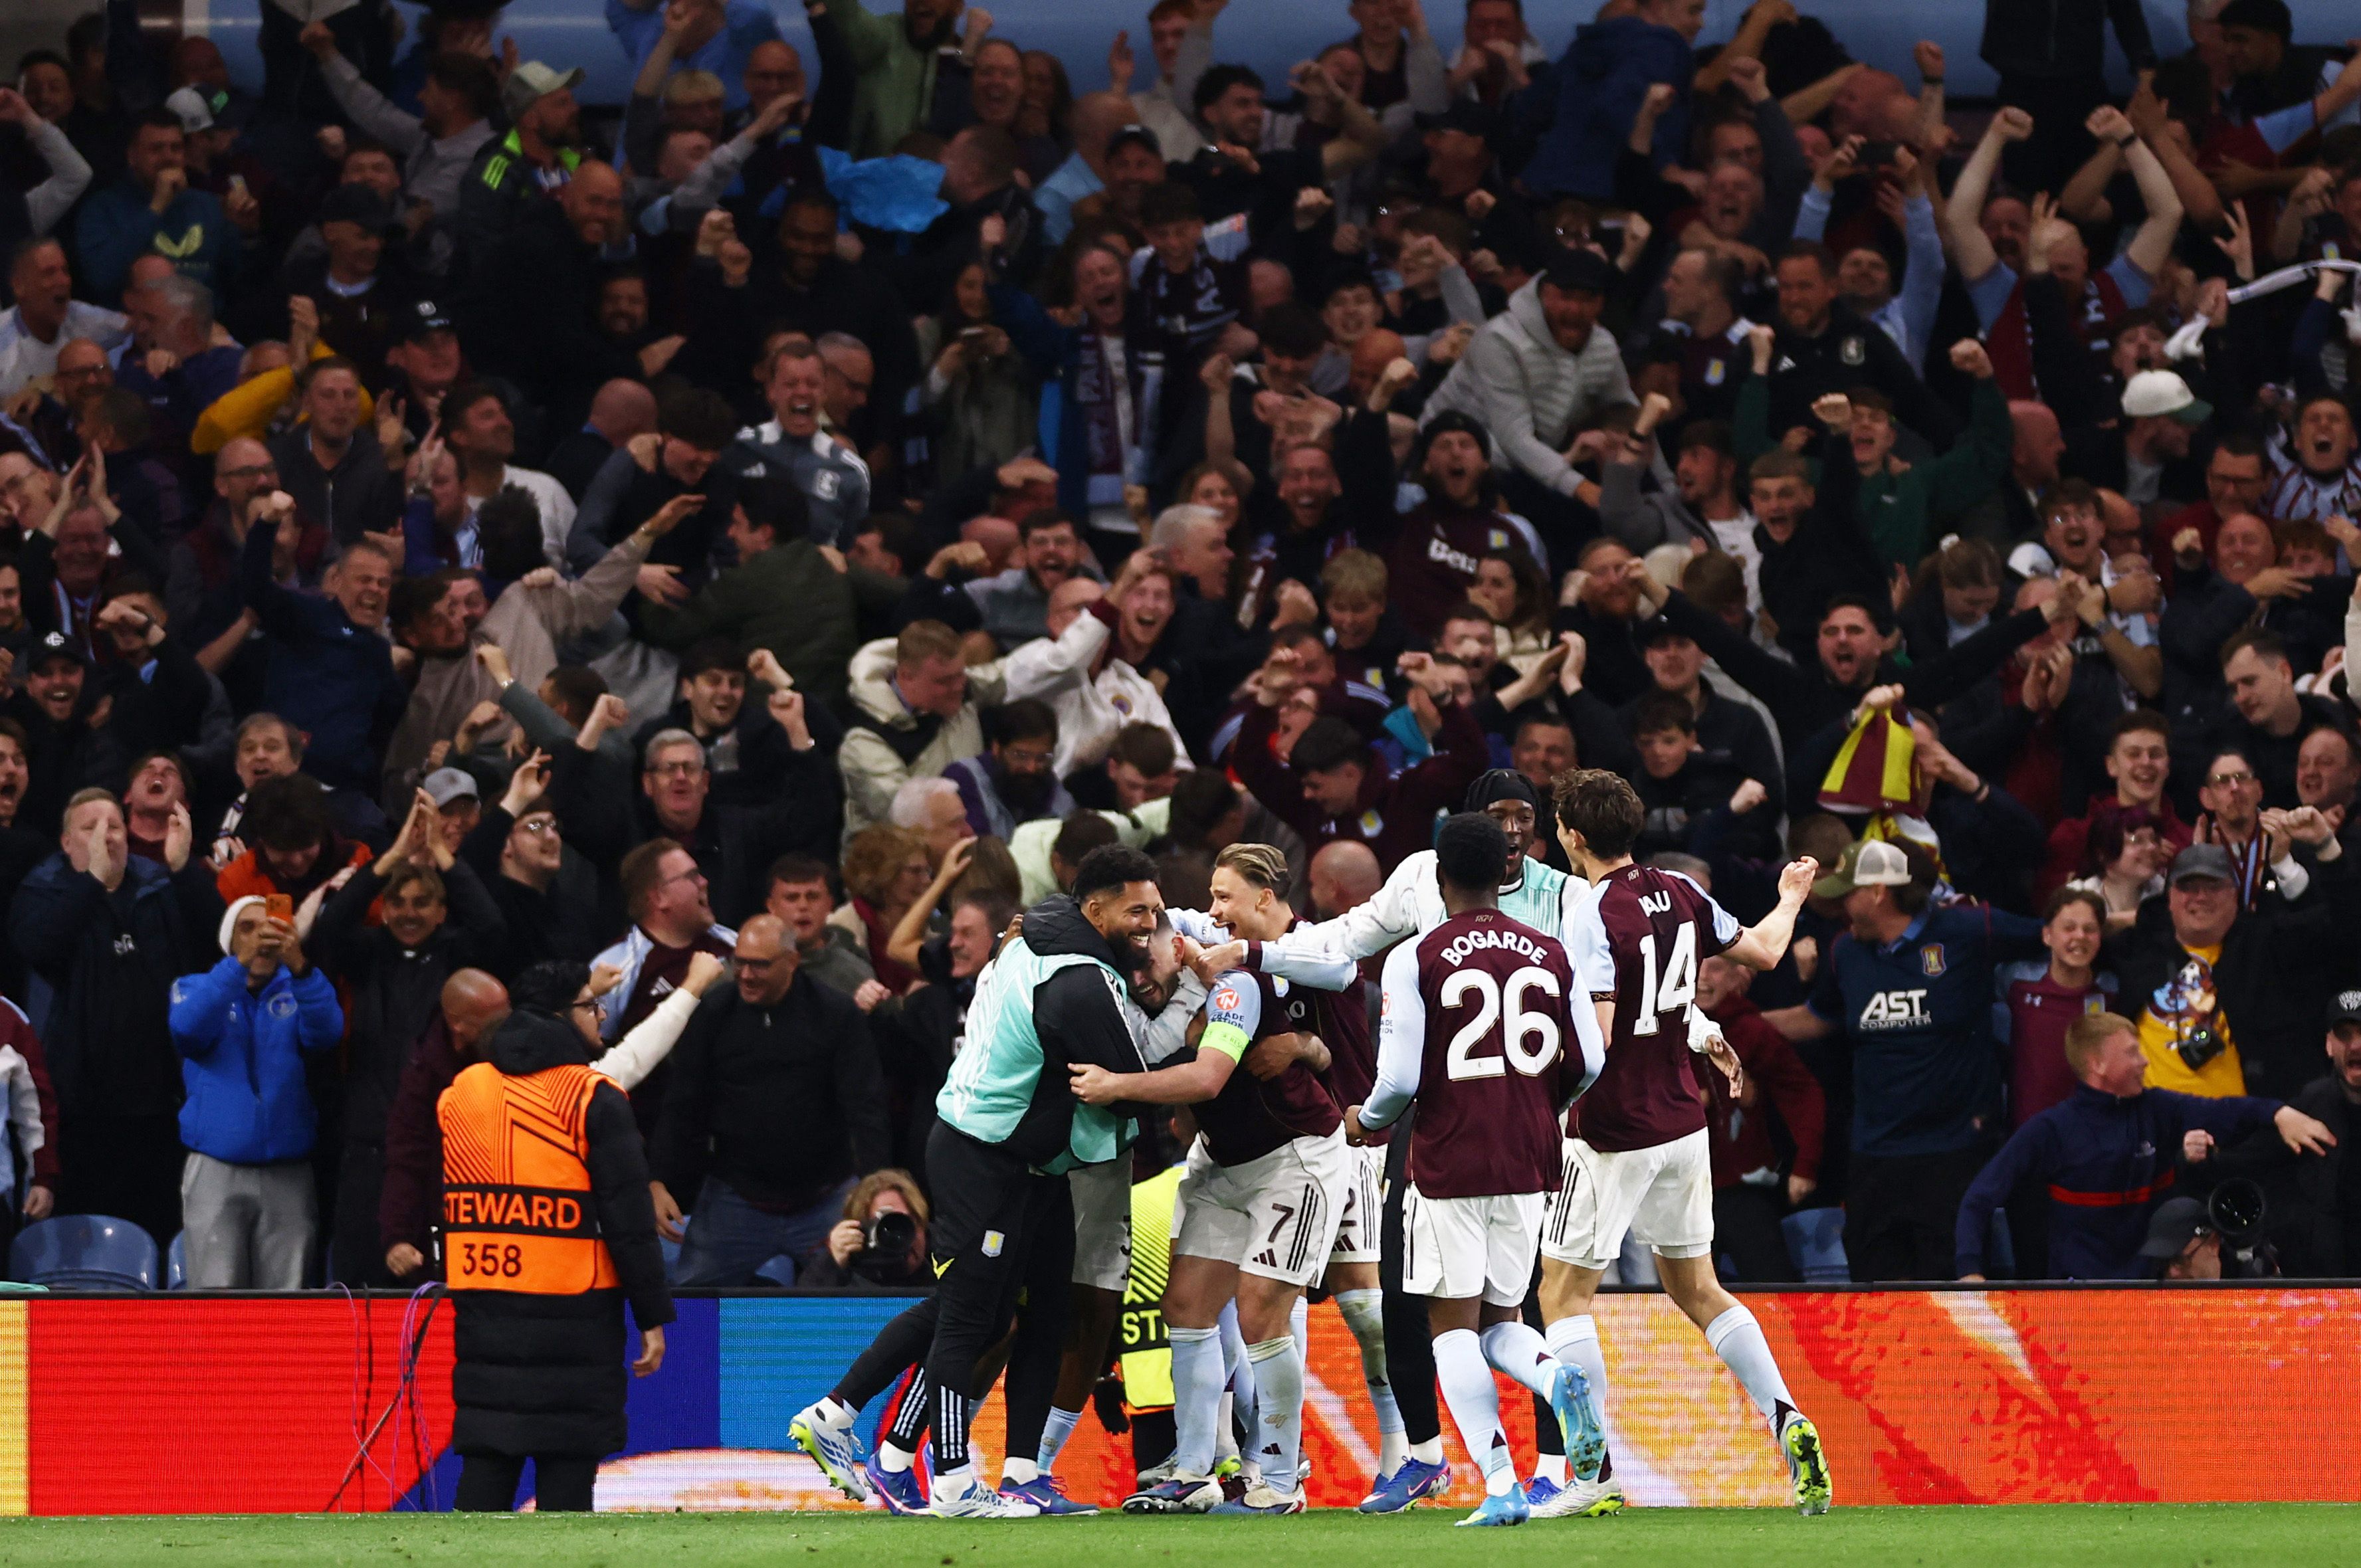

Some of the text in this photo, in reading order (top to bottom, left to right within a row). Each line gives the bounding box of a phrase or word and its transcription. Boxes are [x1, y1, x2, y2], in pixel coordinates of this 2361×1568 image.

[1440, 930, 1548, 967] BOGARDE
[1633, 920, 1698, 1038] 14
[1441, 965, 1562, 1082] 26
[1860, 989, 1928, 1020] AST
[1268, 1203, 1294, 1243] 7
[463, 1243, 522, 1278] 358
